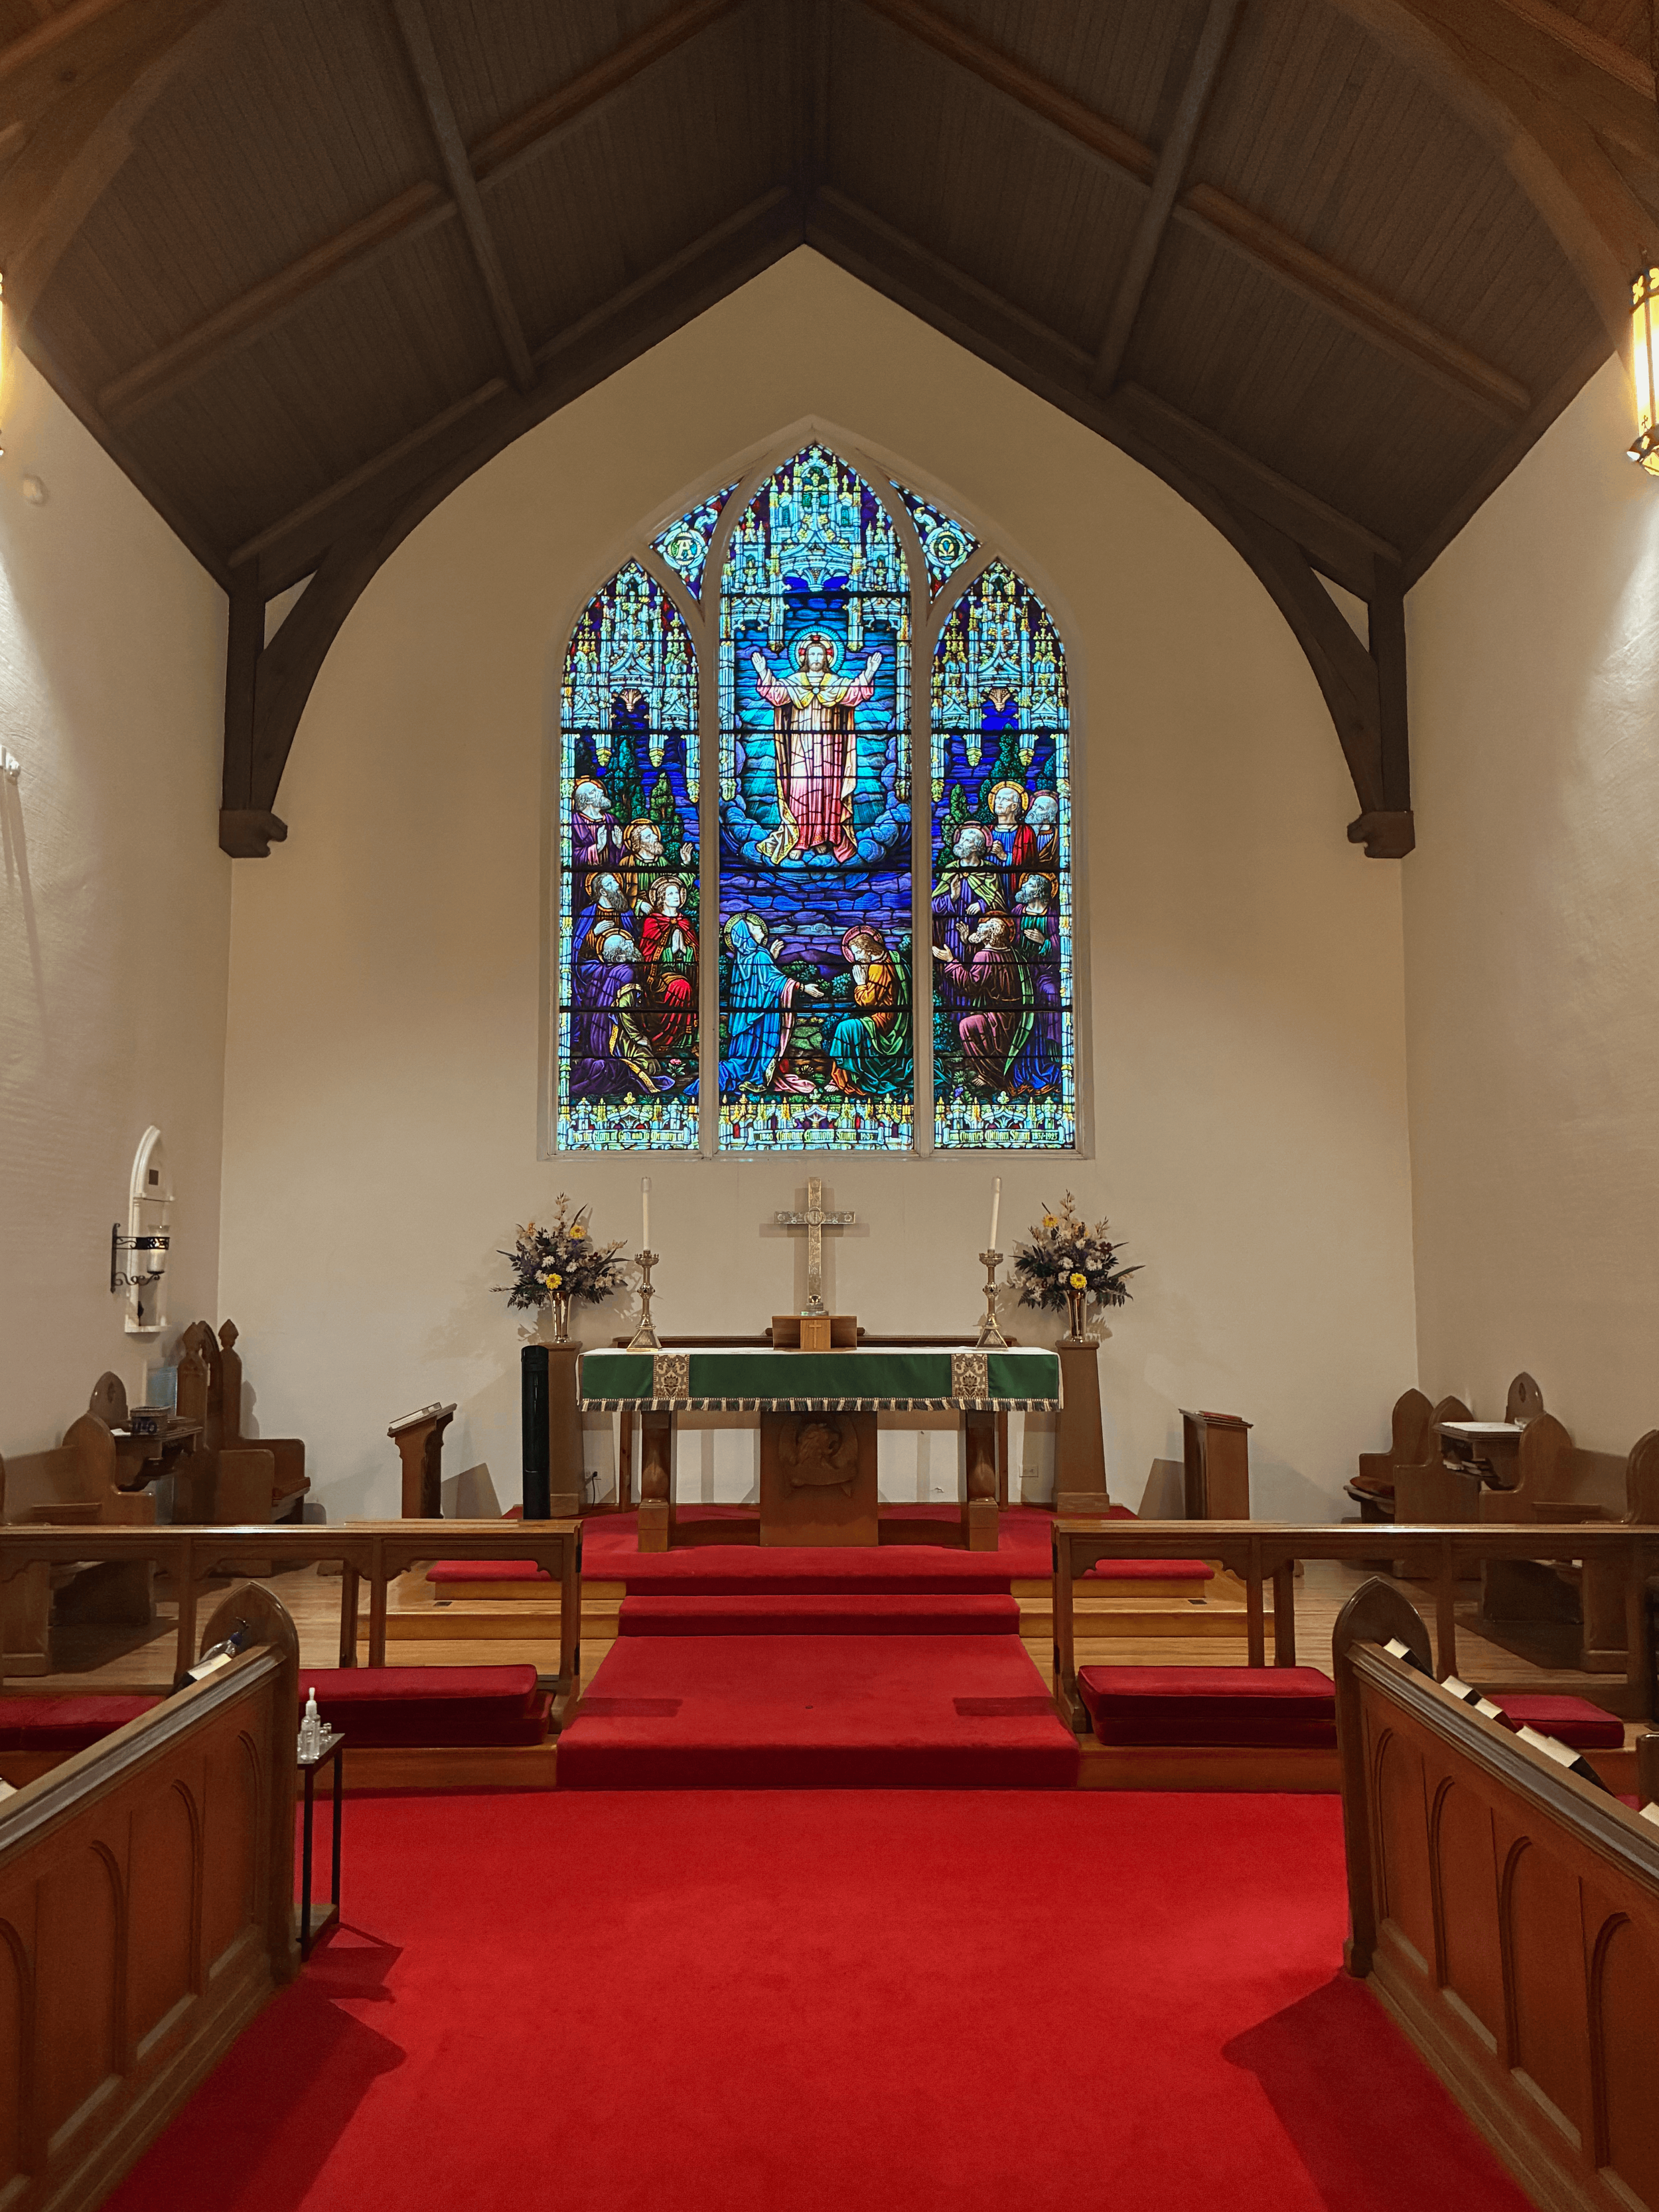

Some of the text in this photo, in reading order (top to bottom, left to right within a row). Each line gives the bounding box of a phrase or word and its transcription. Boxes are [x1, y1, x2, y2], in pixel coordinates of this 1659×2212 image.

[583, 1132, 592, 1141] the
[593, 1131, 610, 1141] Glory
[611, 1131, 617, 1141] of
[618, 1130, 631, 1140] God
[650, 1131, 676, 1142] Memory
[836, 1130, 856, 1141] Stuart
[960, 1131, 983, 1142] Charles
[985, 1130, 1009, 1142] William
[1009, 1130, 1030, 1141] Stuart
